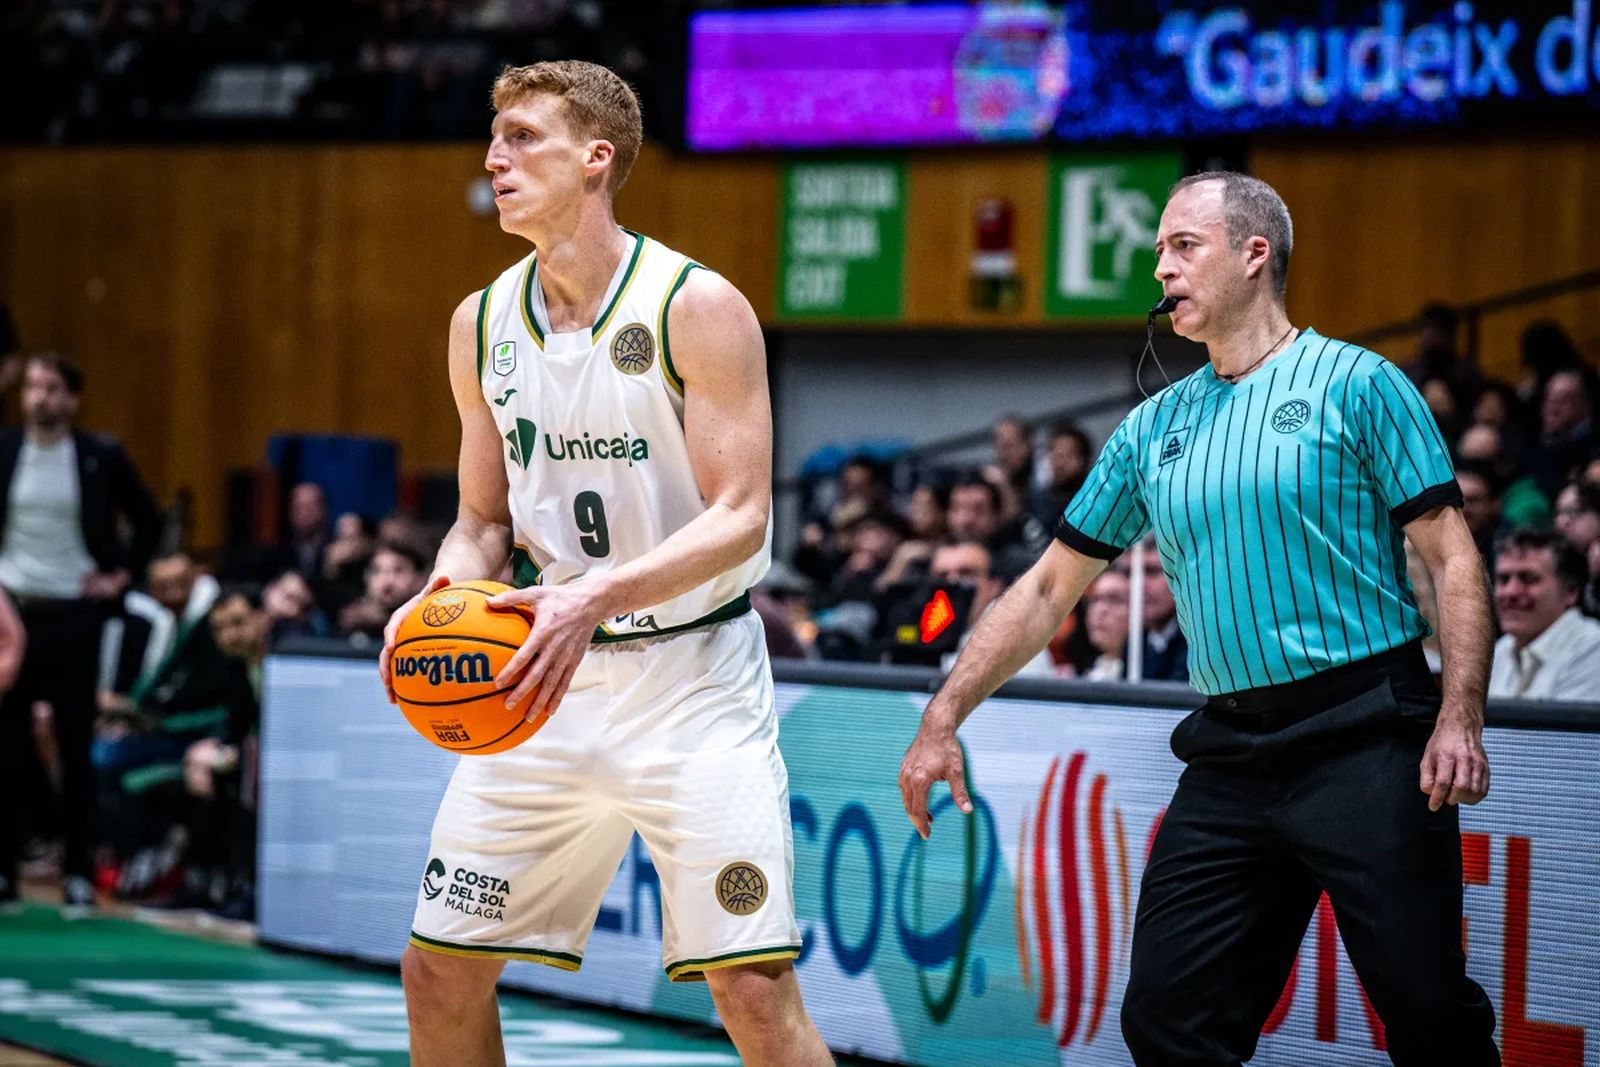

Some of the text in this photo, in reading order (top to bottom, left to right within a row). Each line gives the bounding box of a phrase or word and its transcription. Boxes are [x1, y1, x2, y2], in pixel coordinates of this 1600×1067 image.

[1536, 0, 1600, 95] d
[545, 432, 649, 467] Unicaja
[574, 491, 610, 558] 9
[395, 652, 495, 687] Wilson
[434, 730, 471, 743] FIBA
[449, 883, 507, 908] DEL SOL
[454, 868, 510, 894] COSTA
[444, 897, 504, 921] MÁLAGA
